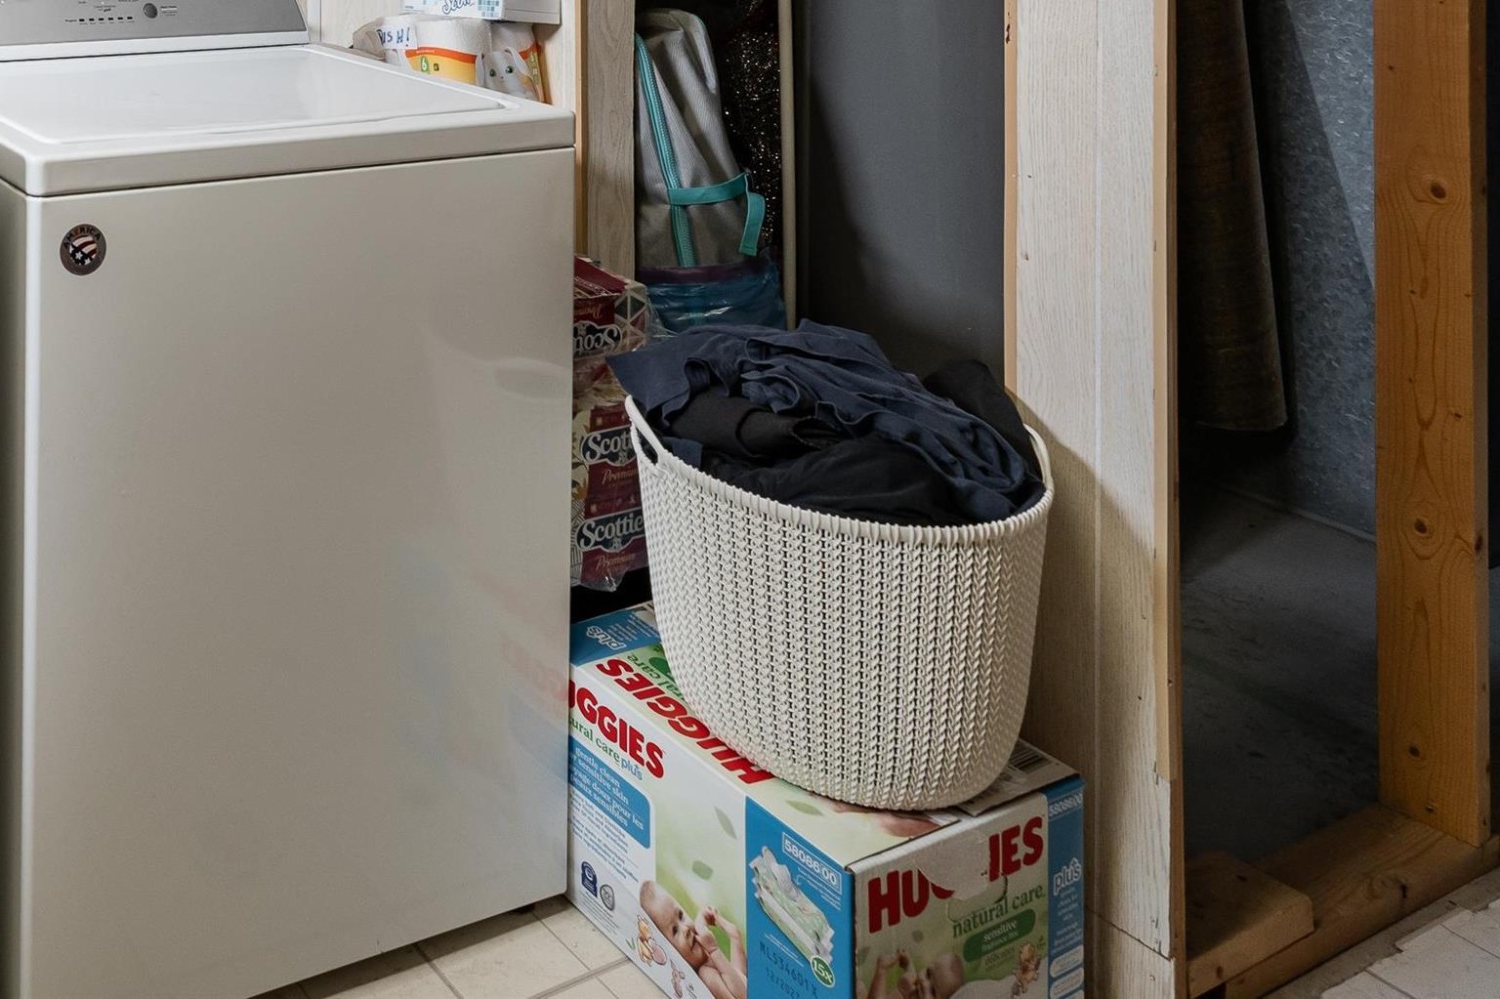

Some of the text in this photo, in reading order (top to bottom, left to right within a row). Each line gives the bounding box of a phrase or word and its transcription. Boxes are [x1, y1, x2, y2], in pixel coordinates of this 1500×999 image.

[569, 717, 643, 782] ural care plus
[868, 815, 1044, 934] HUIES
[1053, 857, 1082, 896] plus
[952, 885, 1044, 939] natural care
[812, 958, 833, 984] 15x
